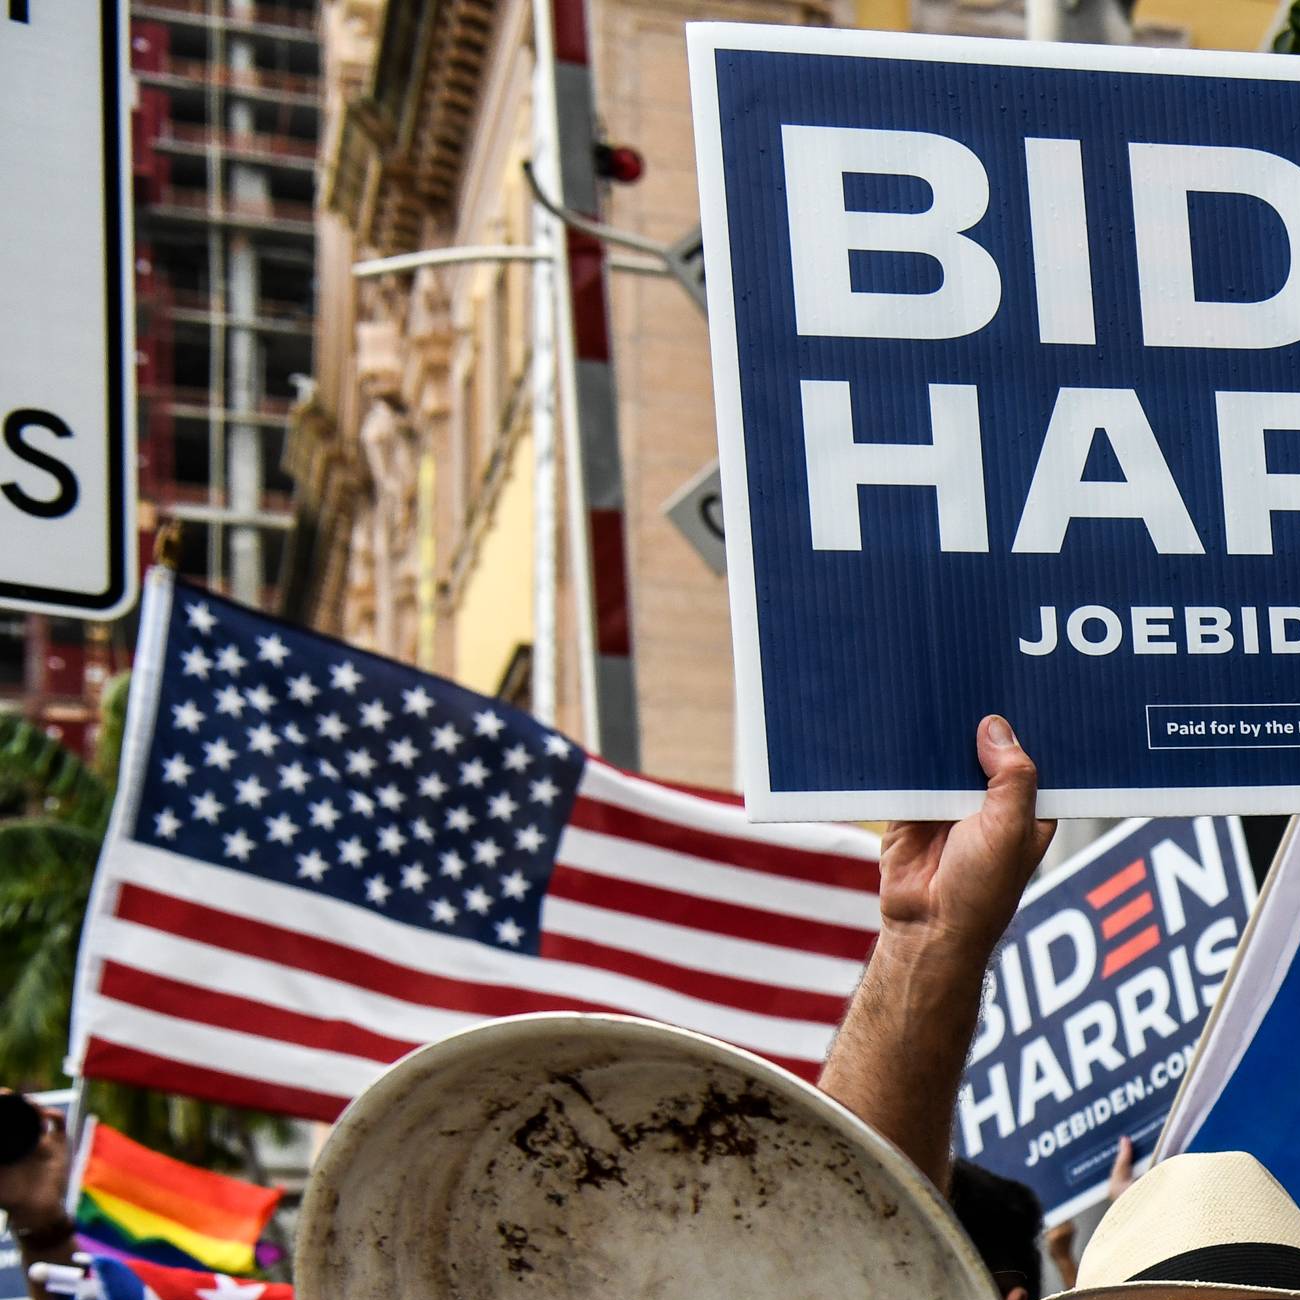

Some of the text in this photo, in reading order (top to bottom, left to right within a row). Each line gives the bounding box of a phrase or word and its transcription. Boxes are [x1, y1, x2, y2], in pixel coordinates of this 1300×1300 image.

[1166, 720, 1206, 736] Paid
[1210, 720, 1236, 735] for
[1239, 720, 1261, 738] by
[1265, 719, 1294, 734] the
